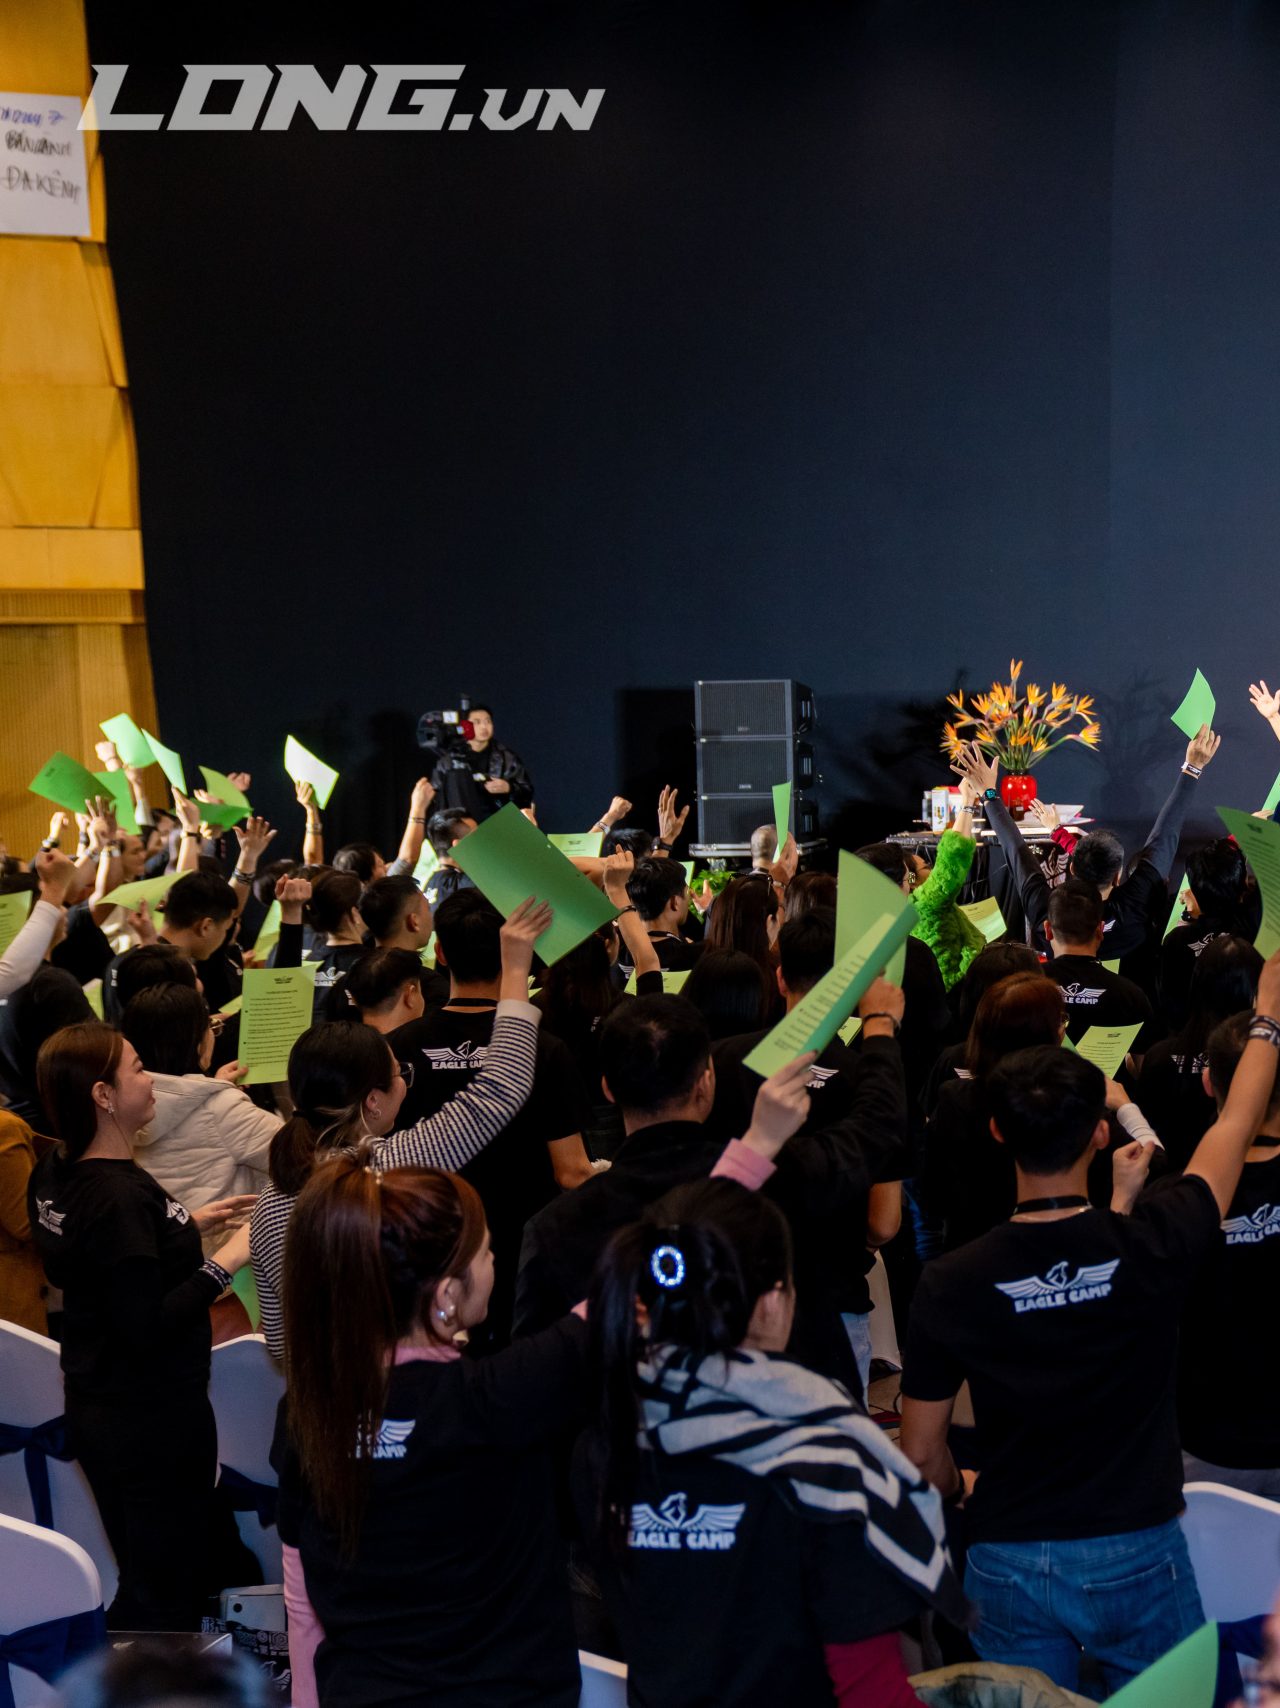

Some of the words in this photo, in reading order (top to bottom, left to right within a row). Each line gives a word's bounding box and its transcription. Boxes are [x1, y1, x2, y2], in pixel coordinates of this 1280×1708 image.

[1075, 997, 1099, 1005] CAMP
[431, 1060, 468, 1071] EAGLE
[1226, 1230, 1265, 1246] EAGLE
[1014, 1292, 1067, 1314] EAGLE
[1068, 1283, 1113, 1304] CAMP
[686, 1531, 737, 1550] CAMP
